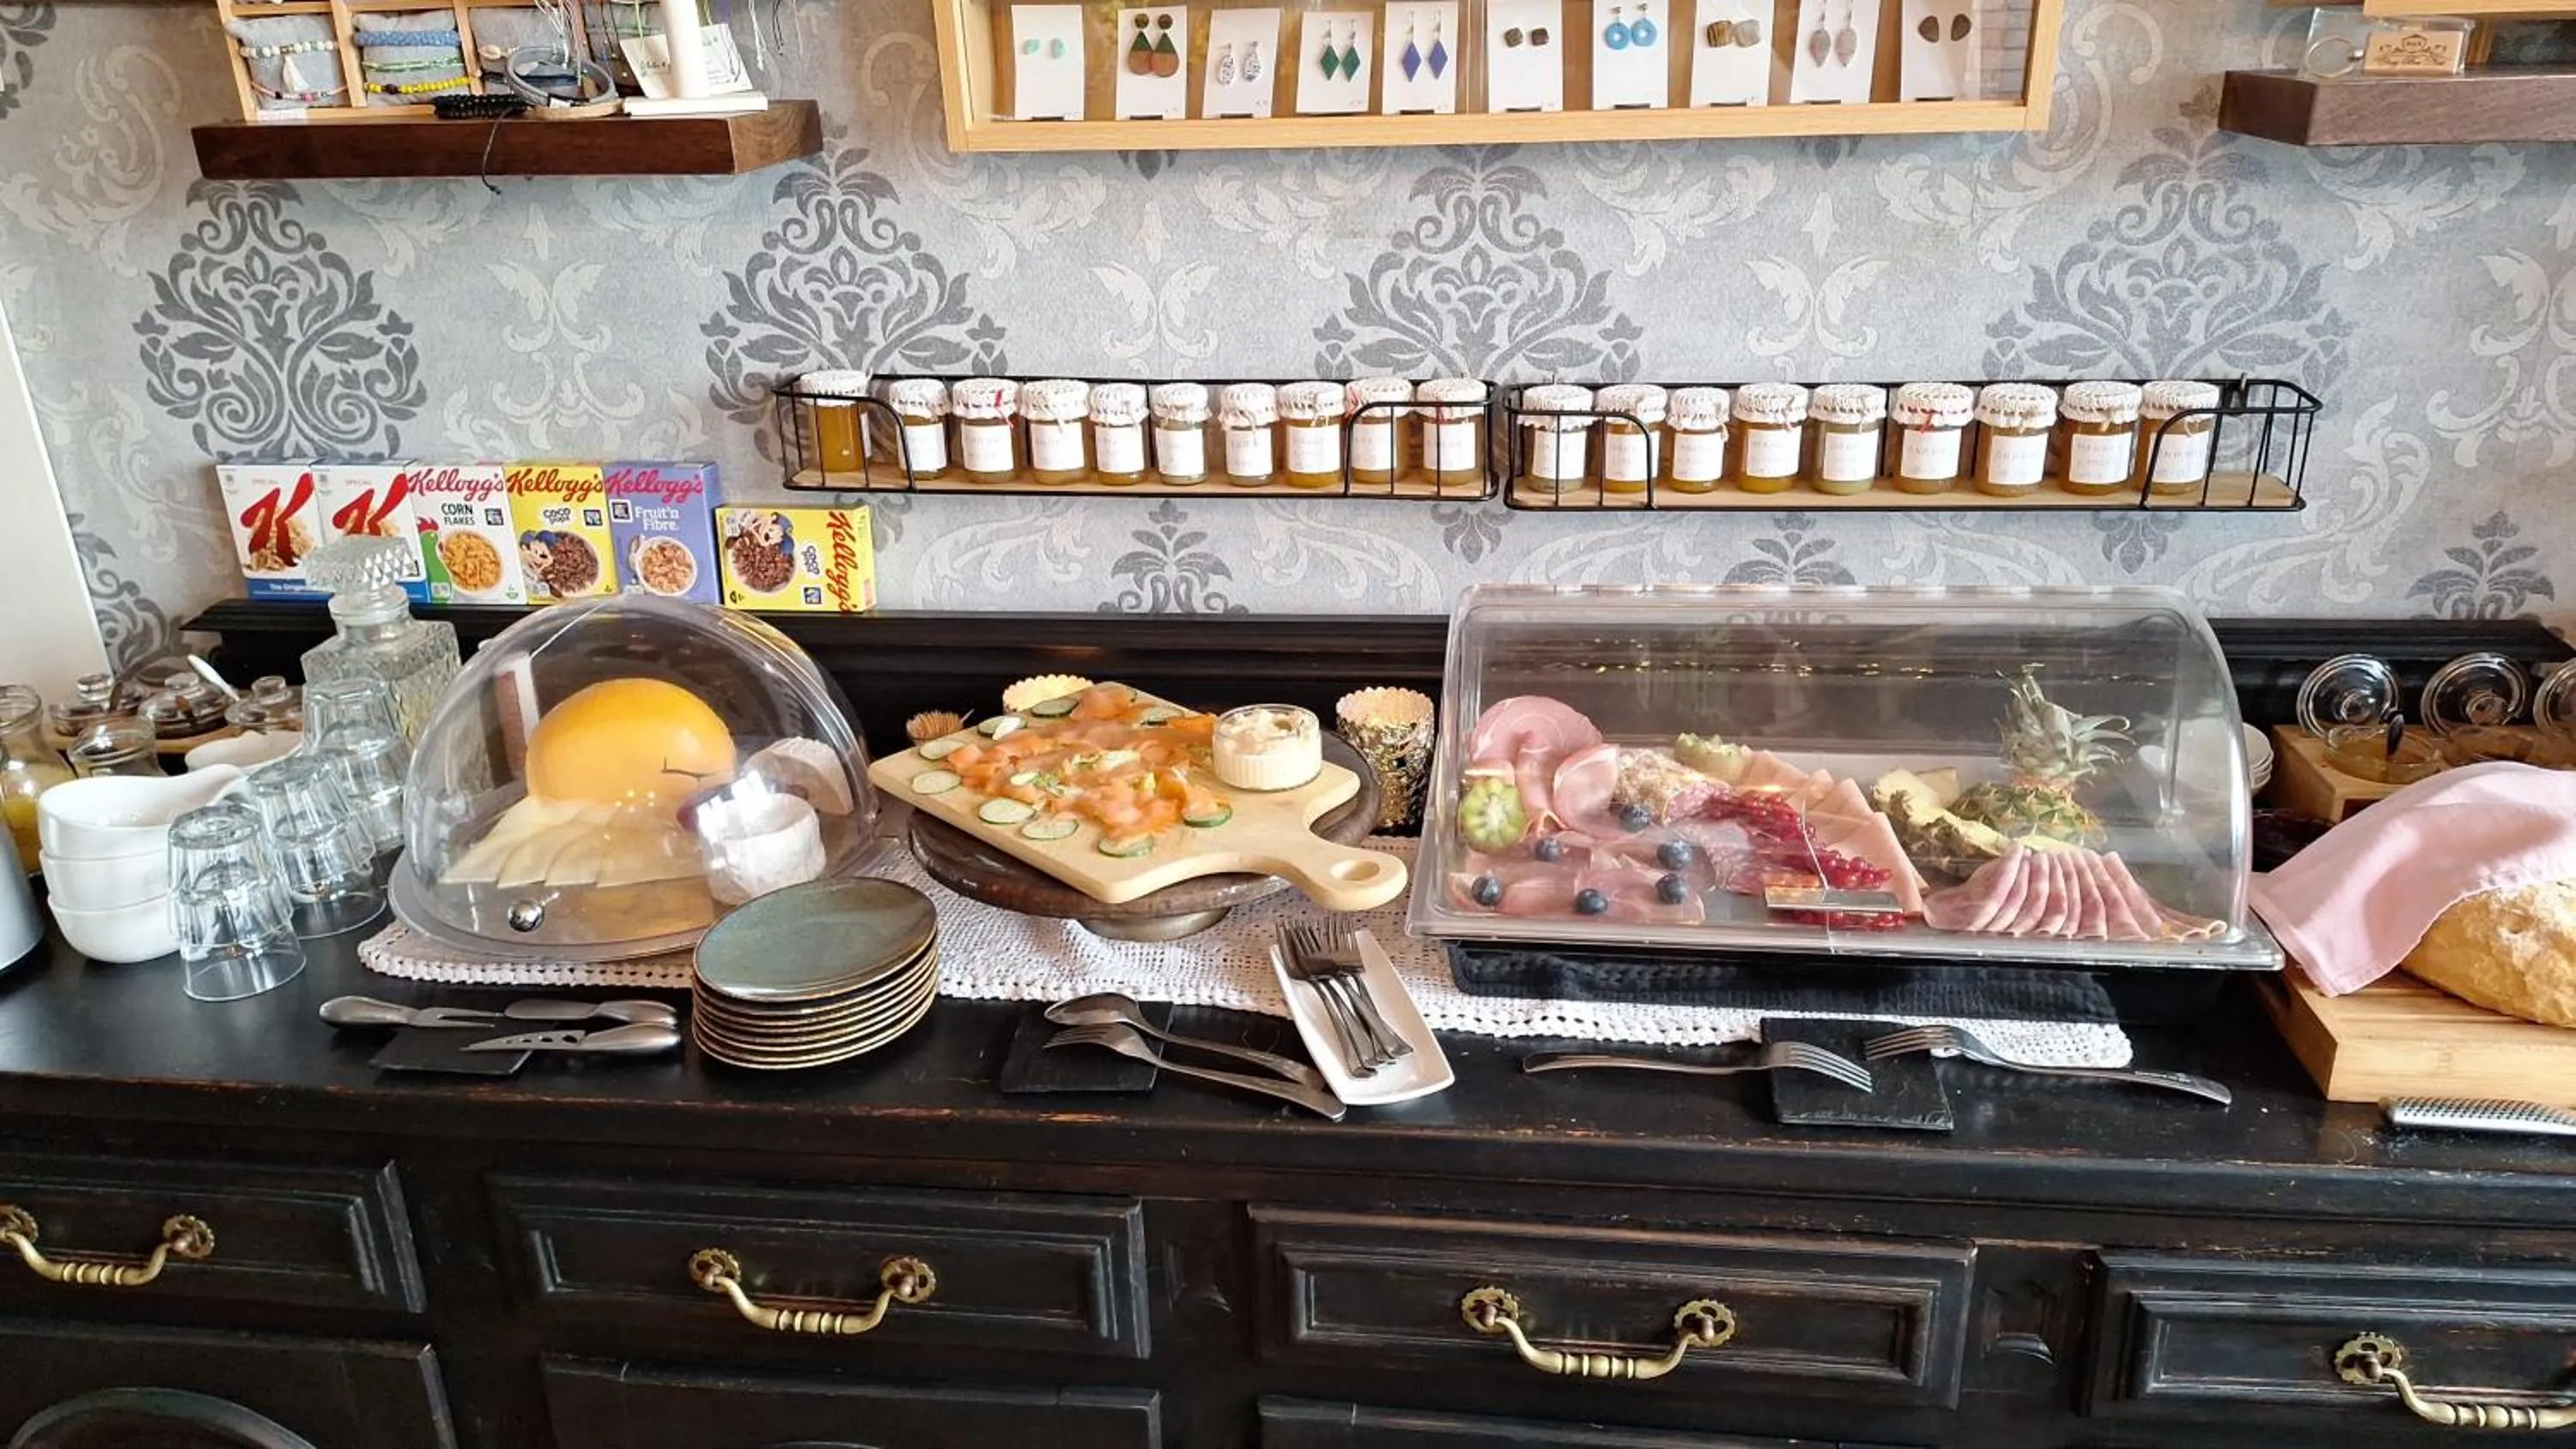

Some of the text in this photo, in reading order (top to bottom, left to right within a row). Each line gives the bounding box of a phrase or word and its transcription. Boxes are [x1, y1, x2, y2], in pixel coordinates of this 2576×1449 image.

[409, 468, 504, 502] Kellogg's
[507, 468, 604, 503] Kellogg's
[605, 468, 704, 505] Kellogg's
[240, 472, 315, 567] K
[441, 503, 473, 516] CORN
[444, 517, 476, 526] FLAKES
[826, 511, 859, 614] Kellogg's
